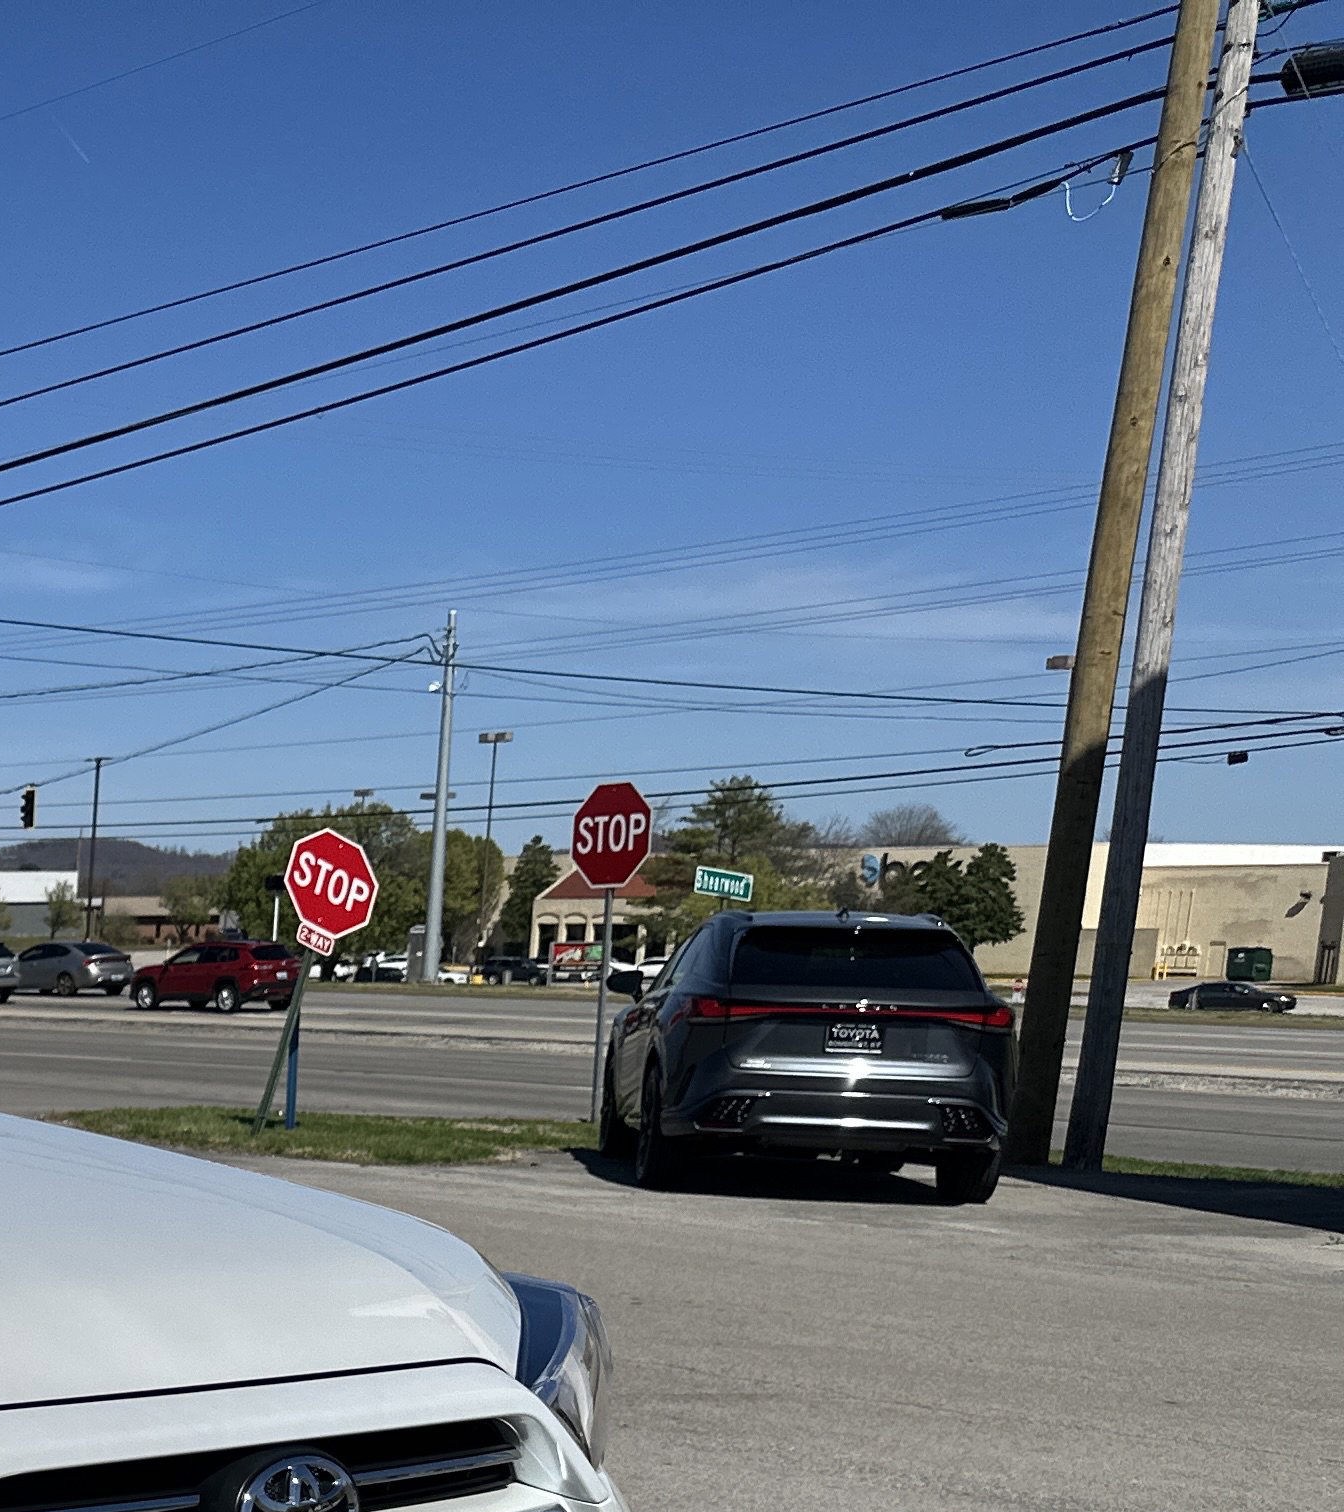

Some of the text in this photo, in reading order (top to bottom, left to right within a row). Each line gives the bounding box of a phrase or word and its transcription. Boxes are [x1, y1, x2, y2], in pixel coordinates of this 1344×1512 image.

[576, 812, 646, 855] STOP
[293, 851, 370, 912] STOP
[300, 927, 331, 951] 2-WAY
[832, 1027, 879, 1039] TOYOTA
